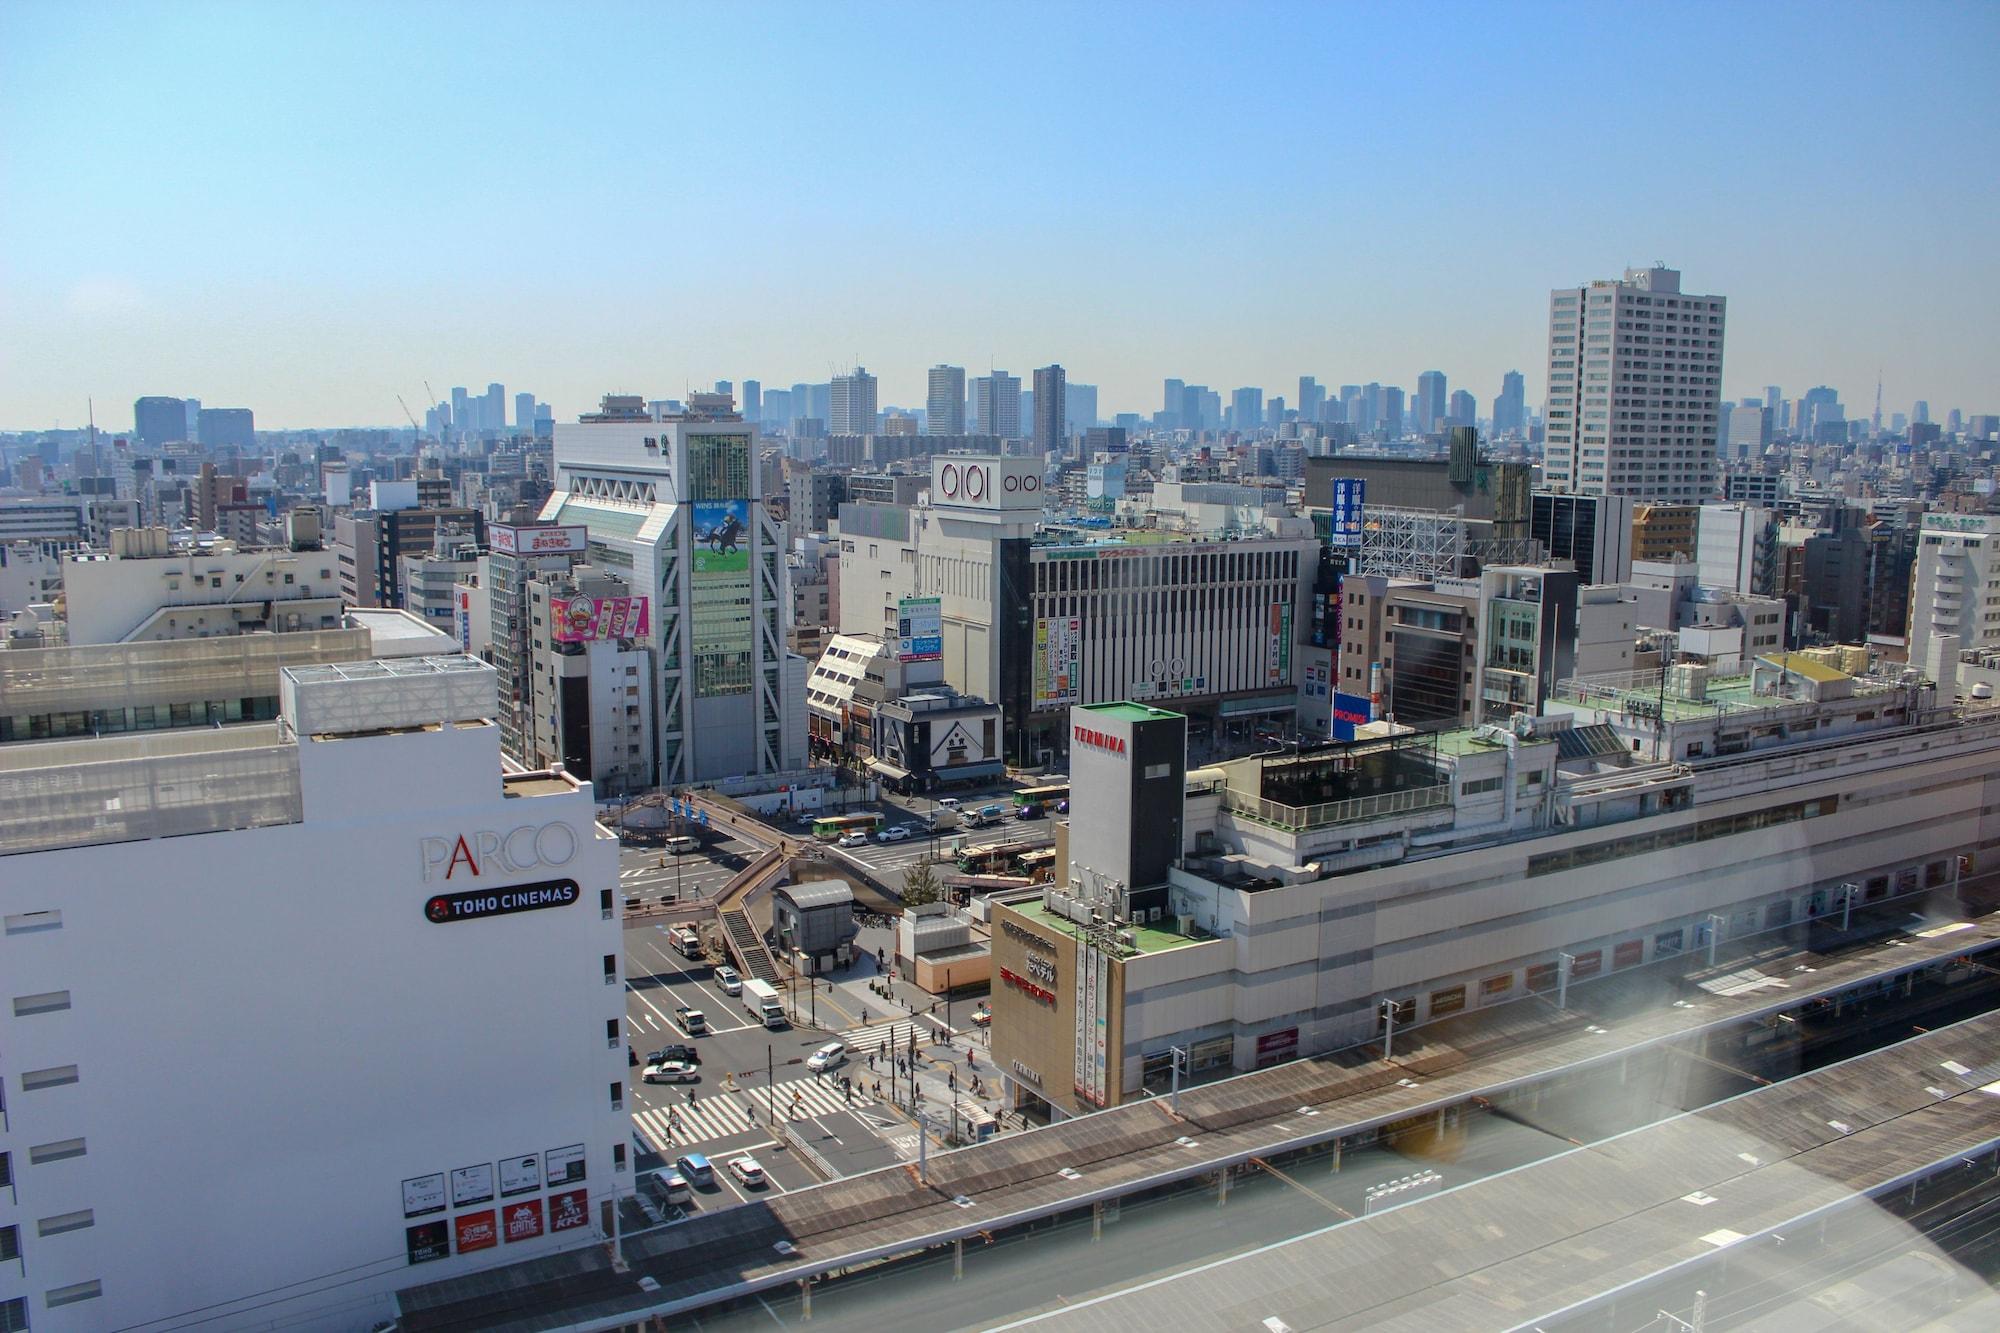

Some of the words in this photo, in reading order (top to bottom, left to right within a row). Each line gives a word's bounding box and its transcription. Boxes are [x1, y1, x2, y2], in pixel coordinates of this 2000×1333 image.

[1334, 708, 1367, 725] PROMISE
[1074, 725, 1125, 753] TERMINA
[420, 821, 580, 883] PARCO
[452, 897, 497, 915] TOHO
[501, 886, 573, 909] CINEMAS
[510, 1217, 537, 1234] GAME
[556, 1215, 583, 1229] KFC
